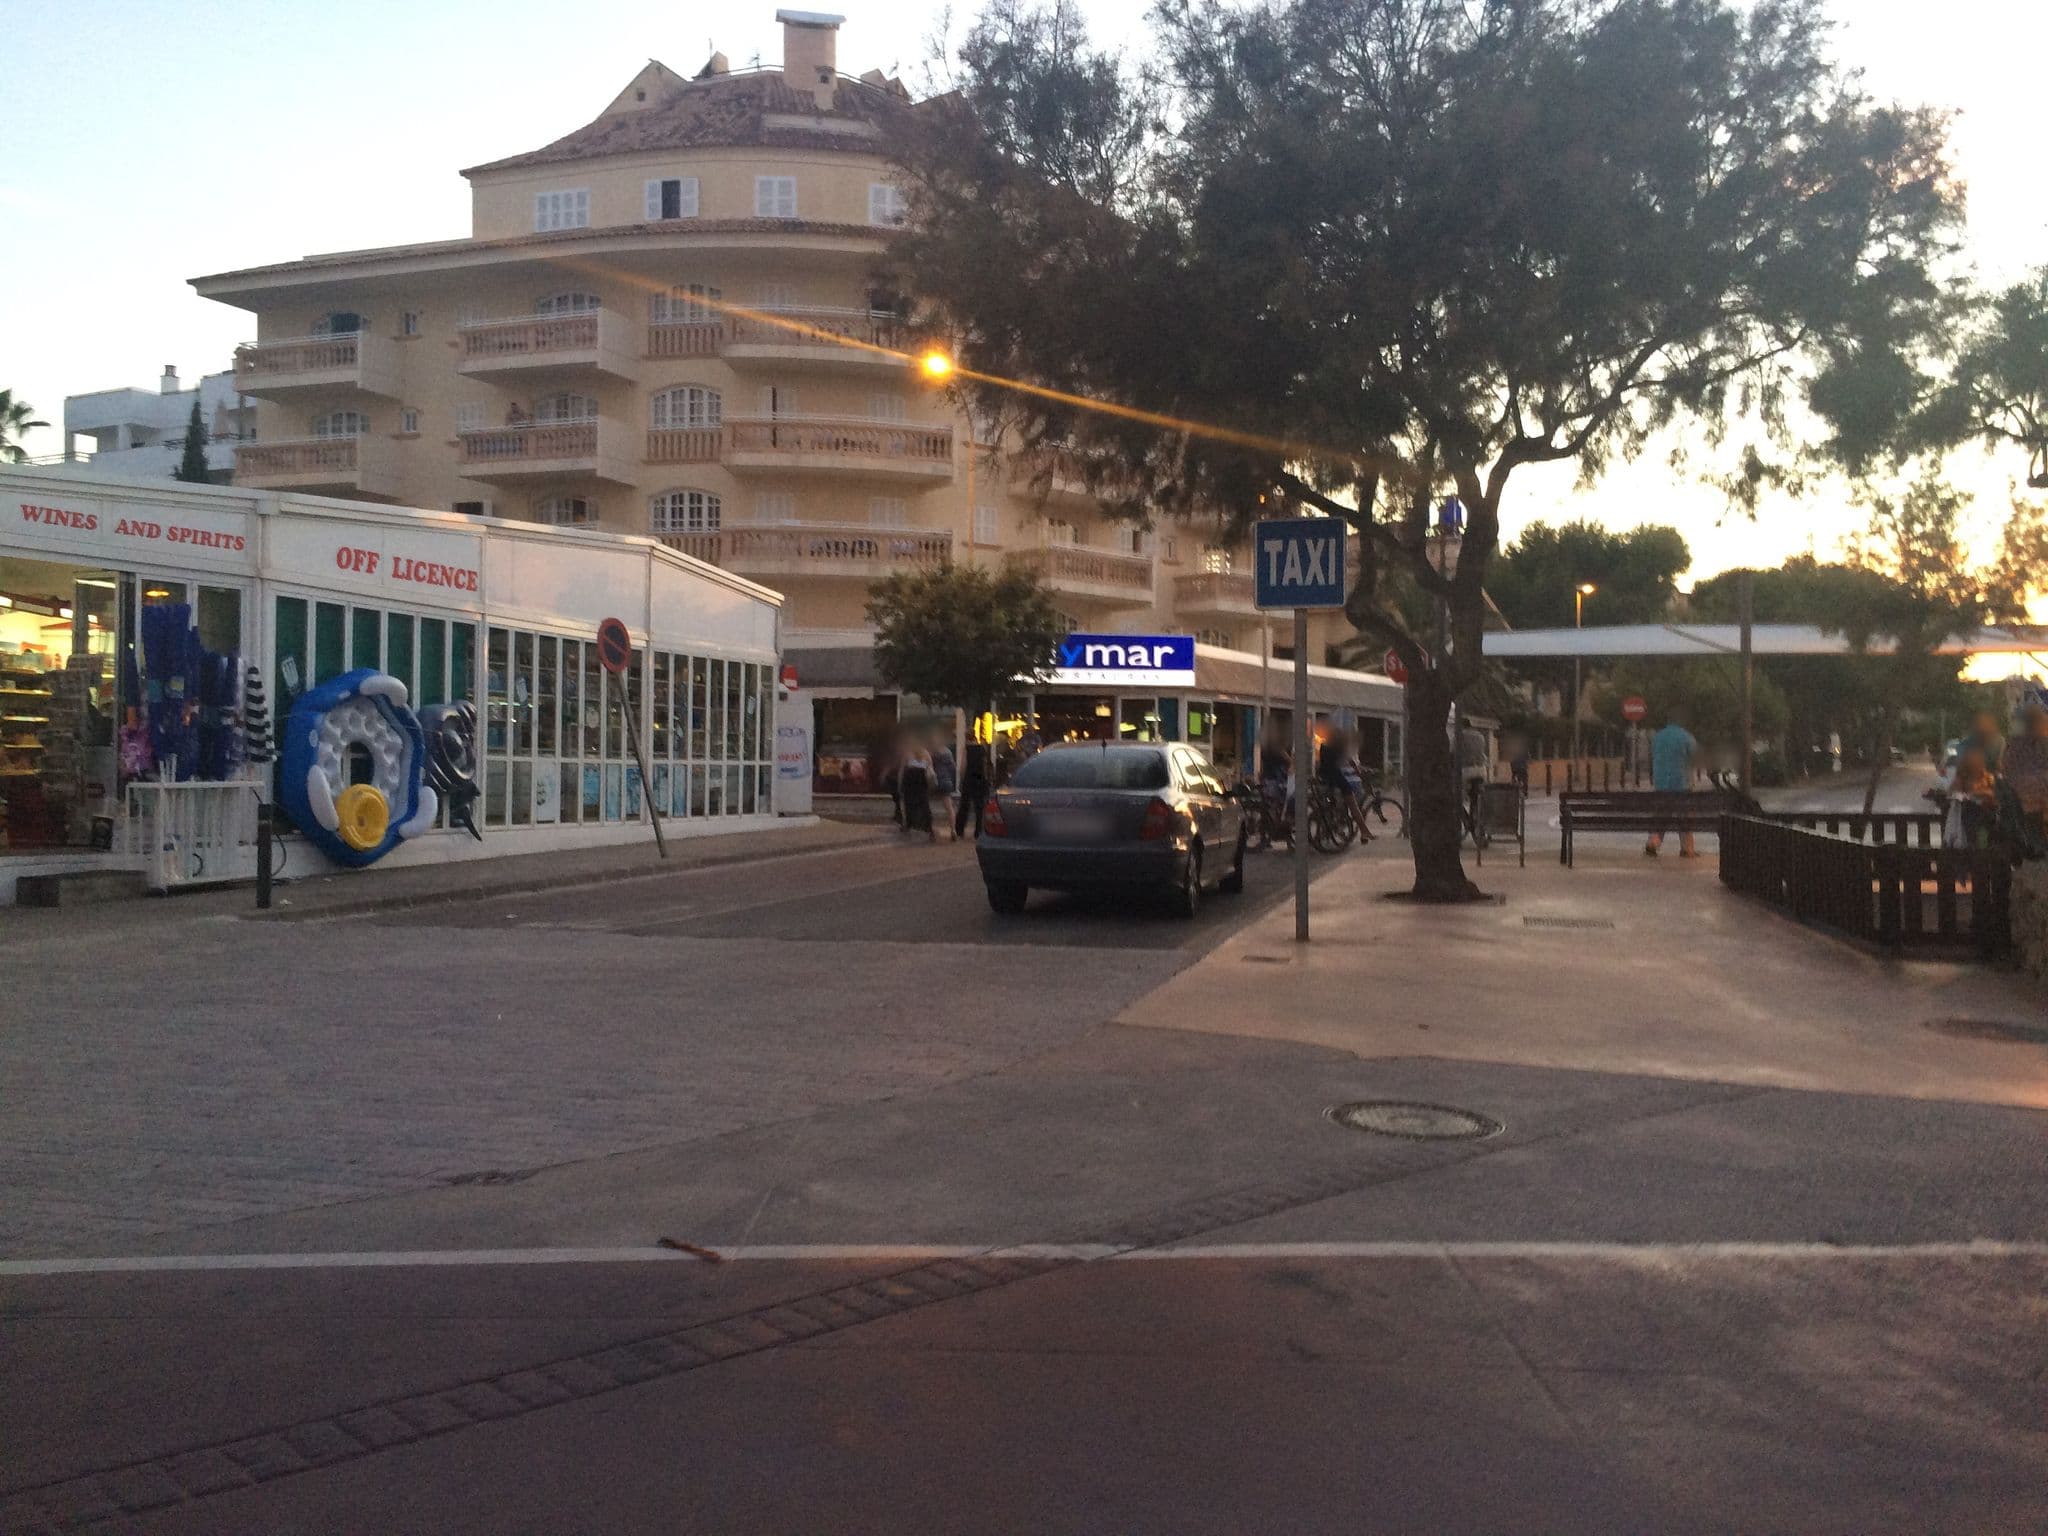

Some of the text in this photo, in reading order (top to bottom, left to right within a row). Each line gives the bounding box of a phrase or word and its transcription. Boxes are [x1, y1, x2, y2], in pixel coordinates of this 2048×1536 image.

[21, 504, 244, 550] WINES AND SPIRITS
[336, 547, 478, 592] OFF LICENCE
[1263, 538, 1336, 587] TAXI
[1051, 643, 1175, 668] ymar
